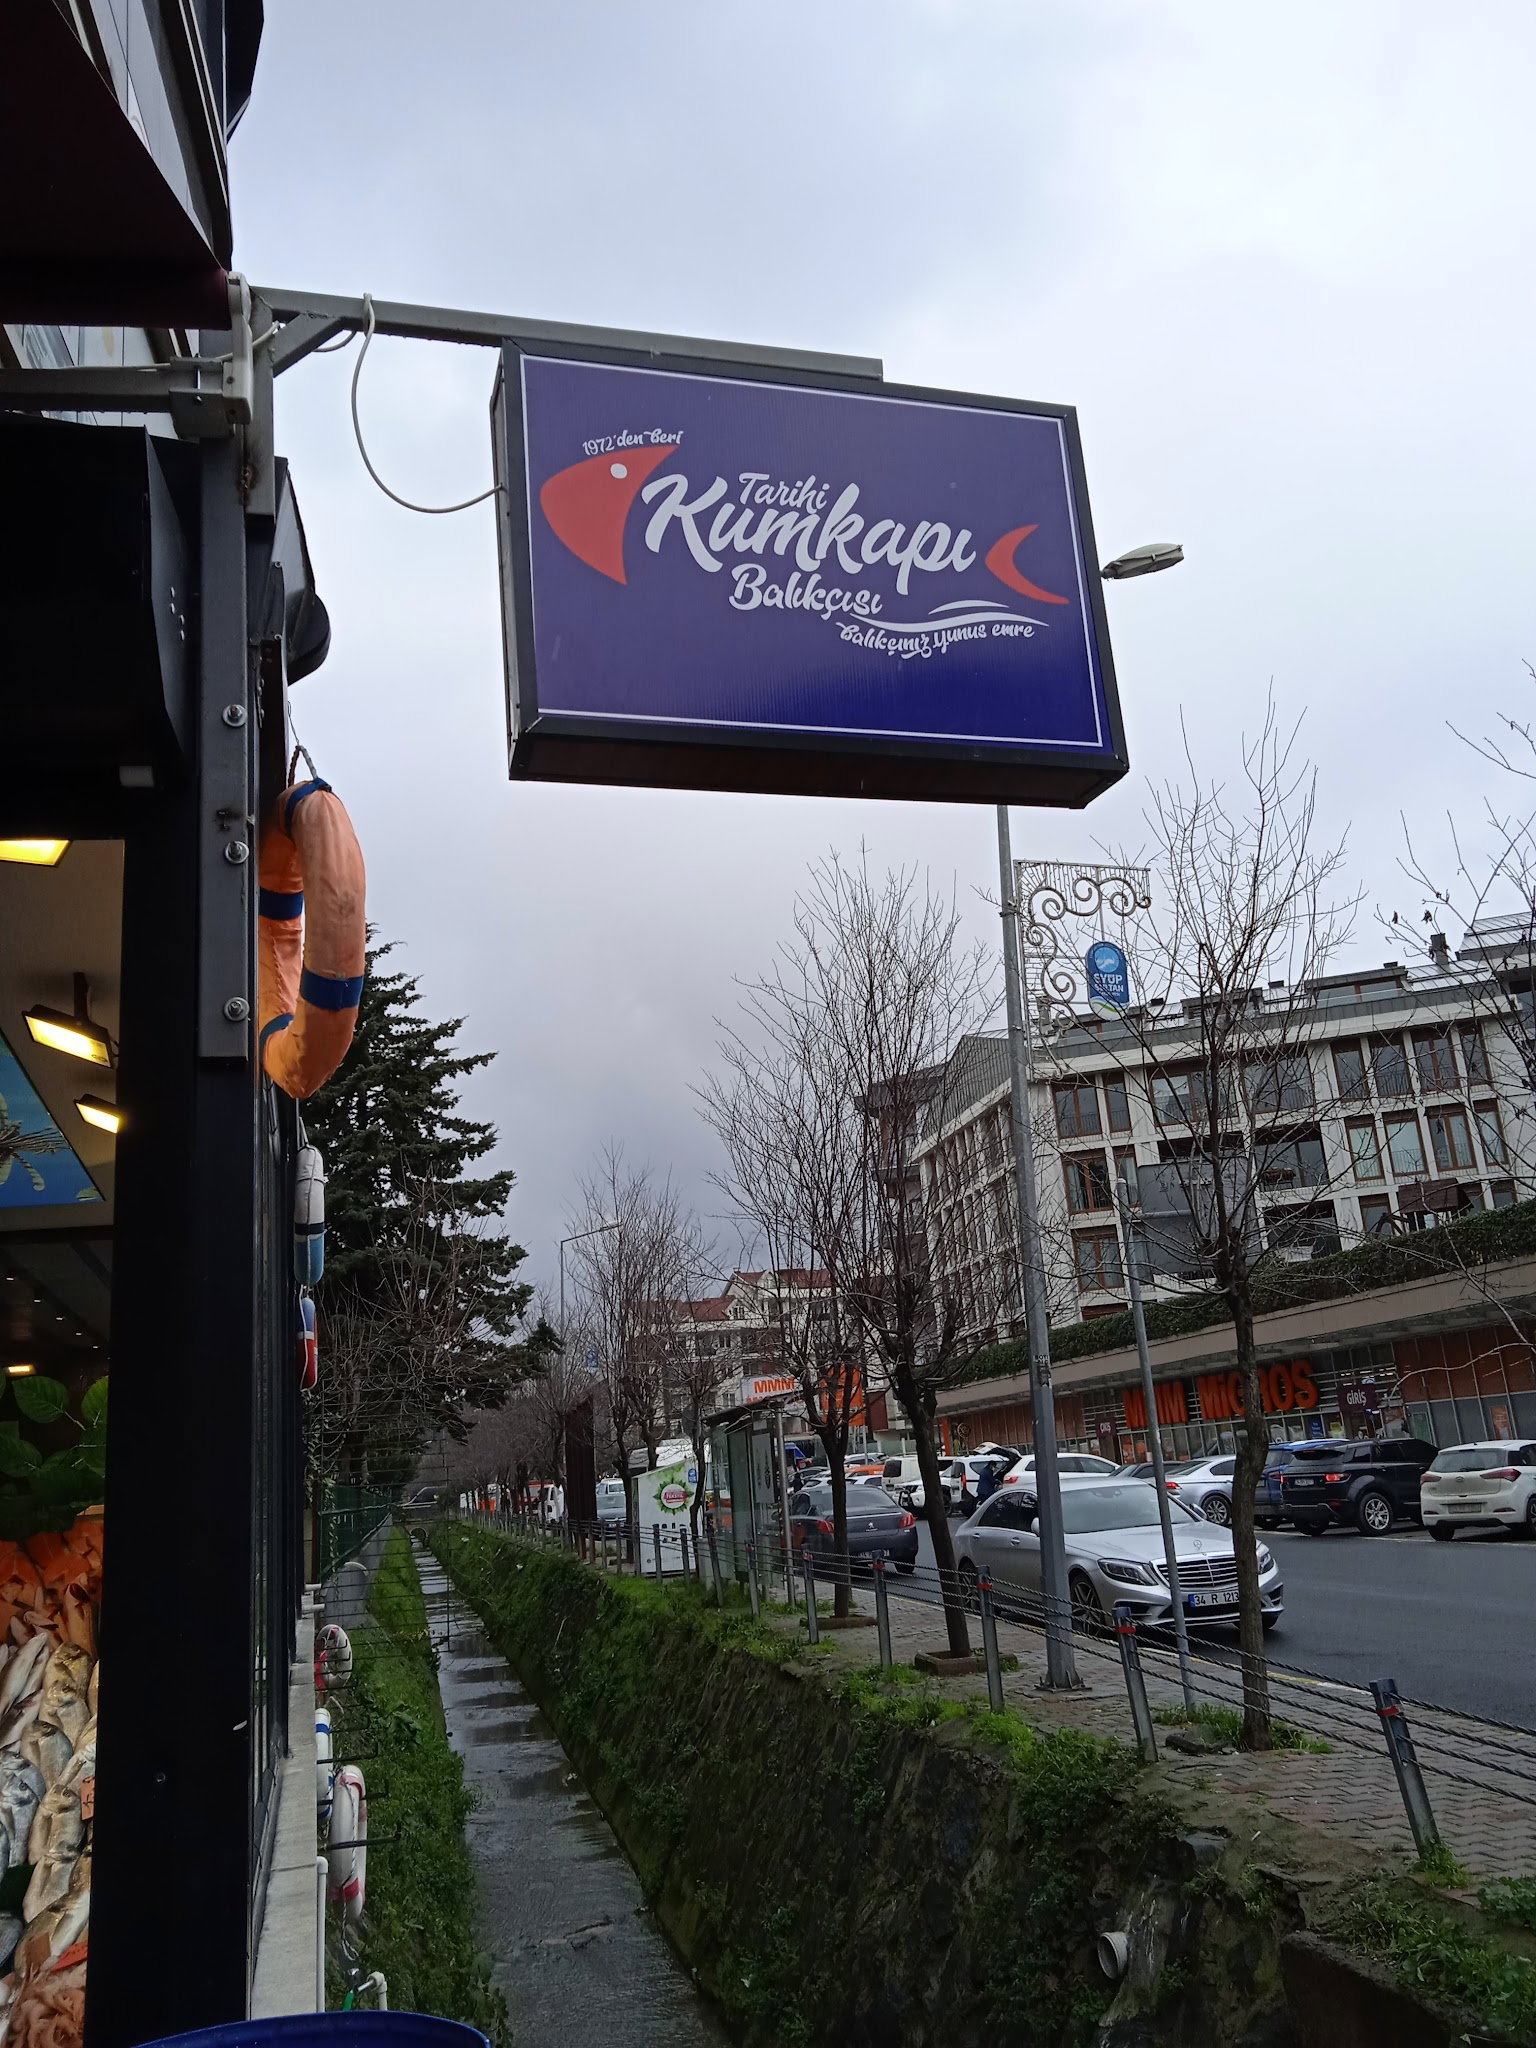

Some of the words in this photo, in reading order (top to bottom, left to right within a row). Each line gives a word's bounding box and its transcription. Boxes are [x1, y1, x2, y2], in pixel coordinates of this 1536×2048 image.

[582, 429, 643, 456] 1972'den
[643, 428, 684, 445] Beri
[738, 472, 830, 515] Tarihi
[641, 473, 977, 596] Kumkapı
[728, 563, 883, 620] Balıkçısı
[991, 622, 1035, 638] emre
[1346, 1388, 1367, 1406] GİRİŞ
[1194, 1595, 1206, 1605] 34
[1211, 1593, 1218, 1603] R
